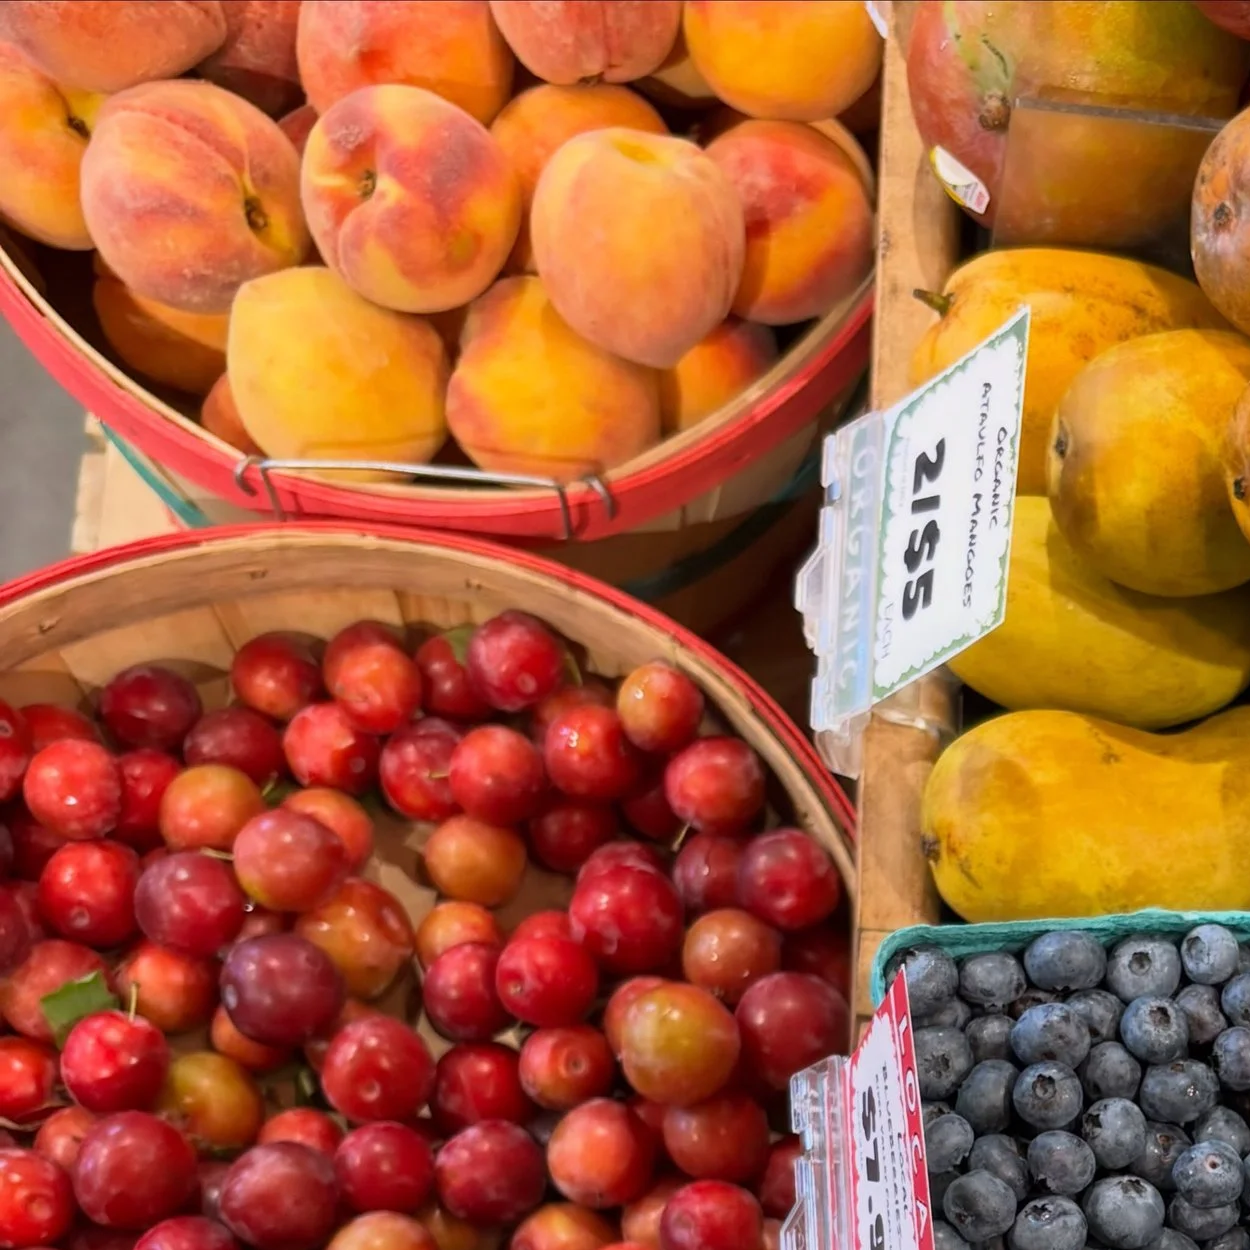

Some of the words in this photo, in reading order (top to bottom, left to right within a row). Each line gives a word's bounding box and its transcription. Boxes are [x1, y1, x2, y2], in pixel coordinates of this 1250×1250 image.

[973, 382, 993, 482] ATAULFO
[988, 427, 1009, 530] ORGANIC
[961, 493, 984, 609] MANGOES
[897, 1132, 909, 1220] LOCAL
